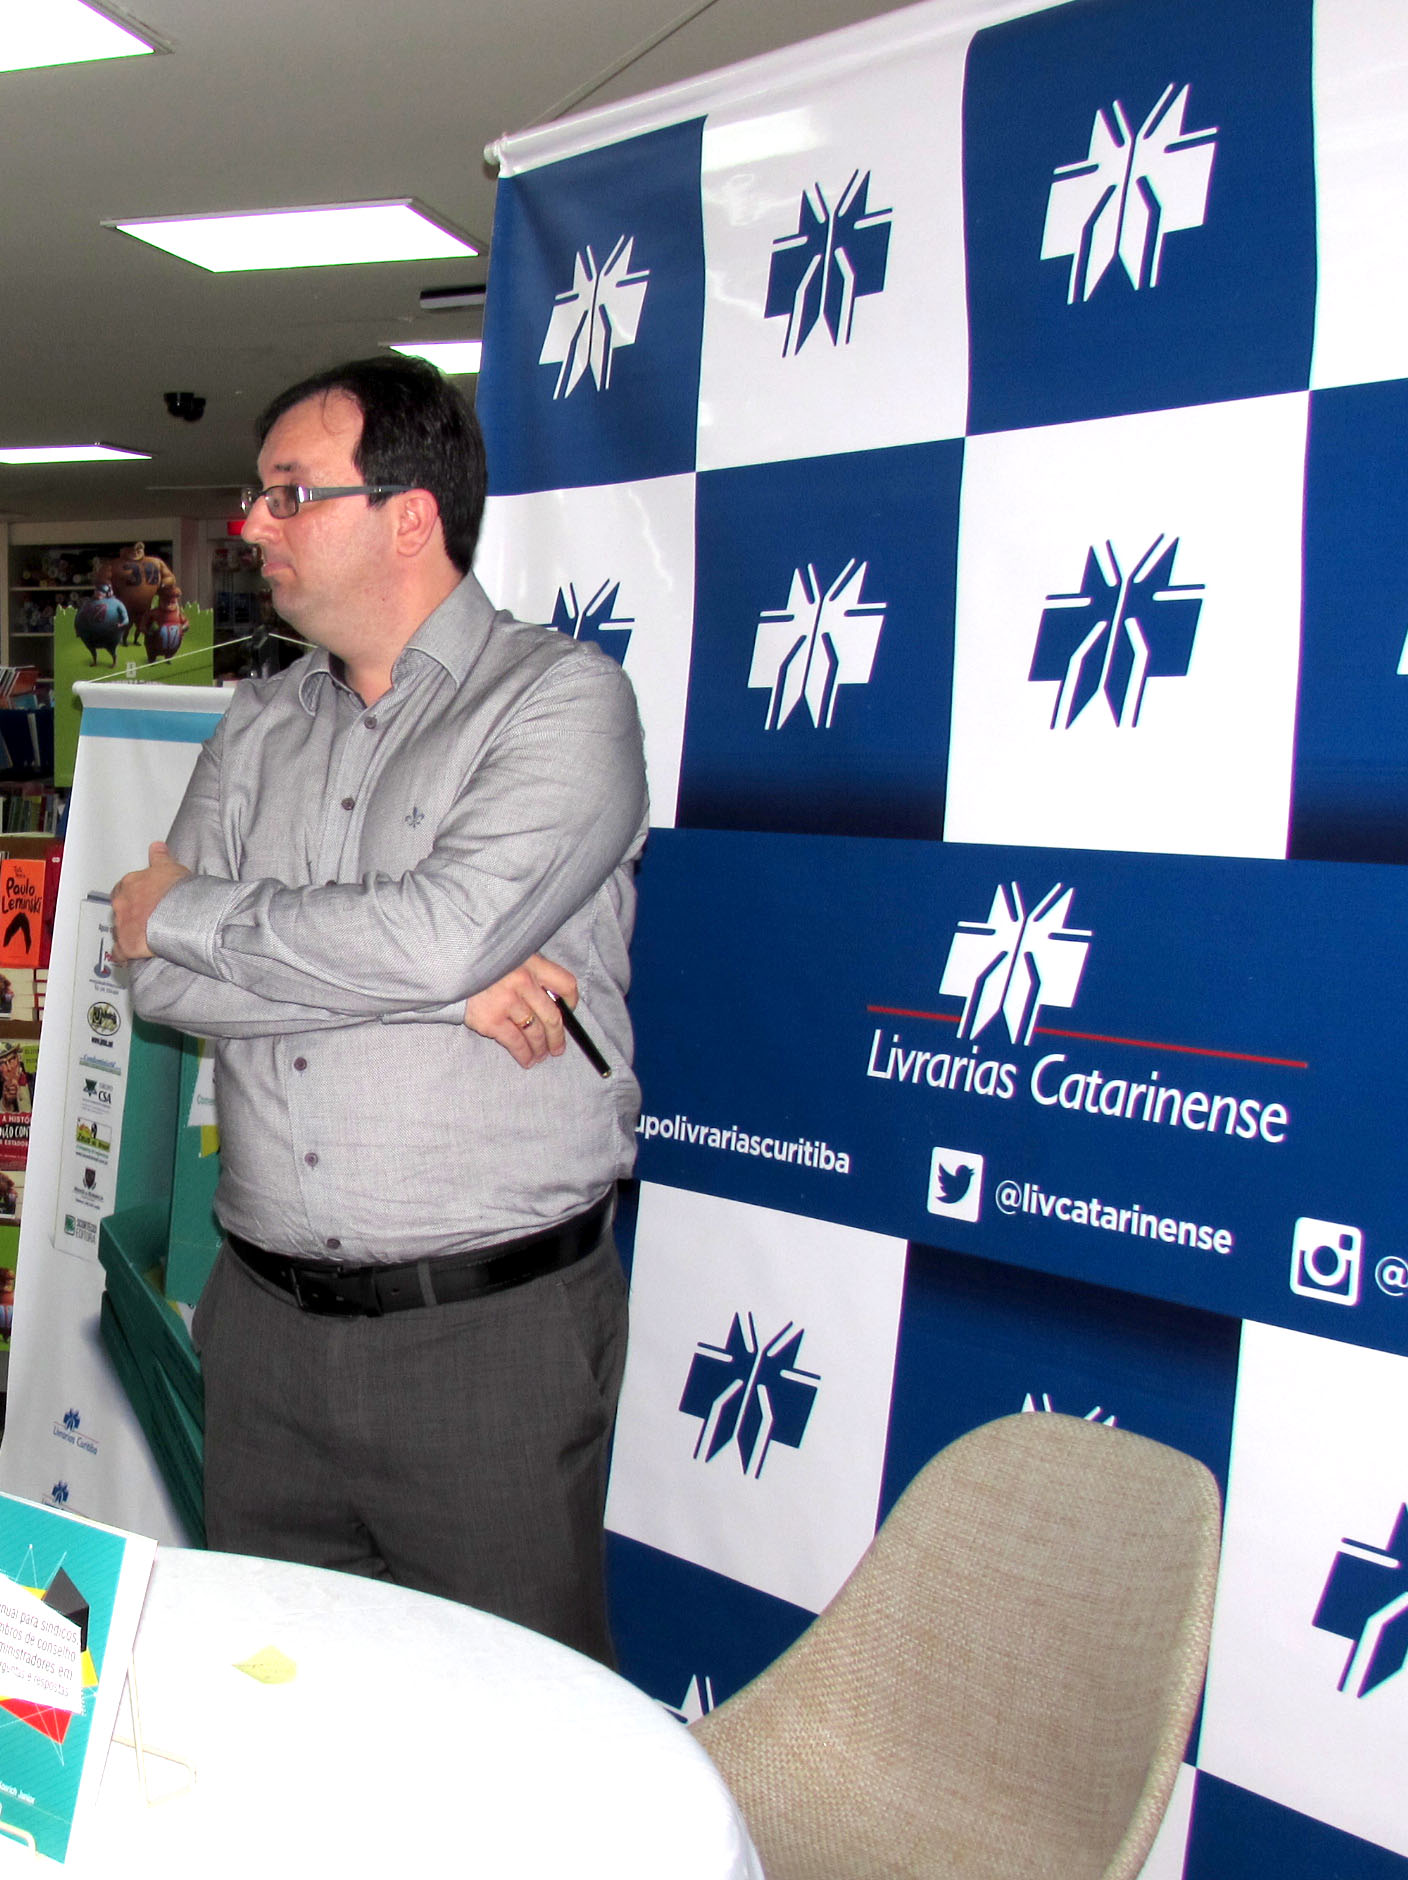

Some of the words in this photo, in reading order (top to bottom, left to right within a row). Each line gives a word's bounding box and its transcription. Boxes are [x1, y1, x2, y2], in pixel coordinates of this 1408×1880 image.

[6, 877, 35, 897] Paulo
[1, 895, 43, 914] Leminski
[867, 1029, 1016, 1099] Livrarias
[1030, 1054, 1289, 1143] Catarinense
[98, 1090, 112, 1105] CSA
[9, 1115, 30, 1124] HISTÓ
[0, 1124, 13, 1139] NÃO
[995, 1180, 1233, 1254] @livcatarinense
[53, 1426, 75, 1445] Livrarias
[20, 1612, 39, 1628] para
[25, 1631, 35, 1644] de
[37, 1638, 76, 1662] conselho
[58, 1666, 73, 1681] em
[33, 1675, 69, 1697] respostas
